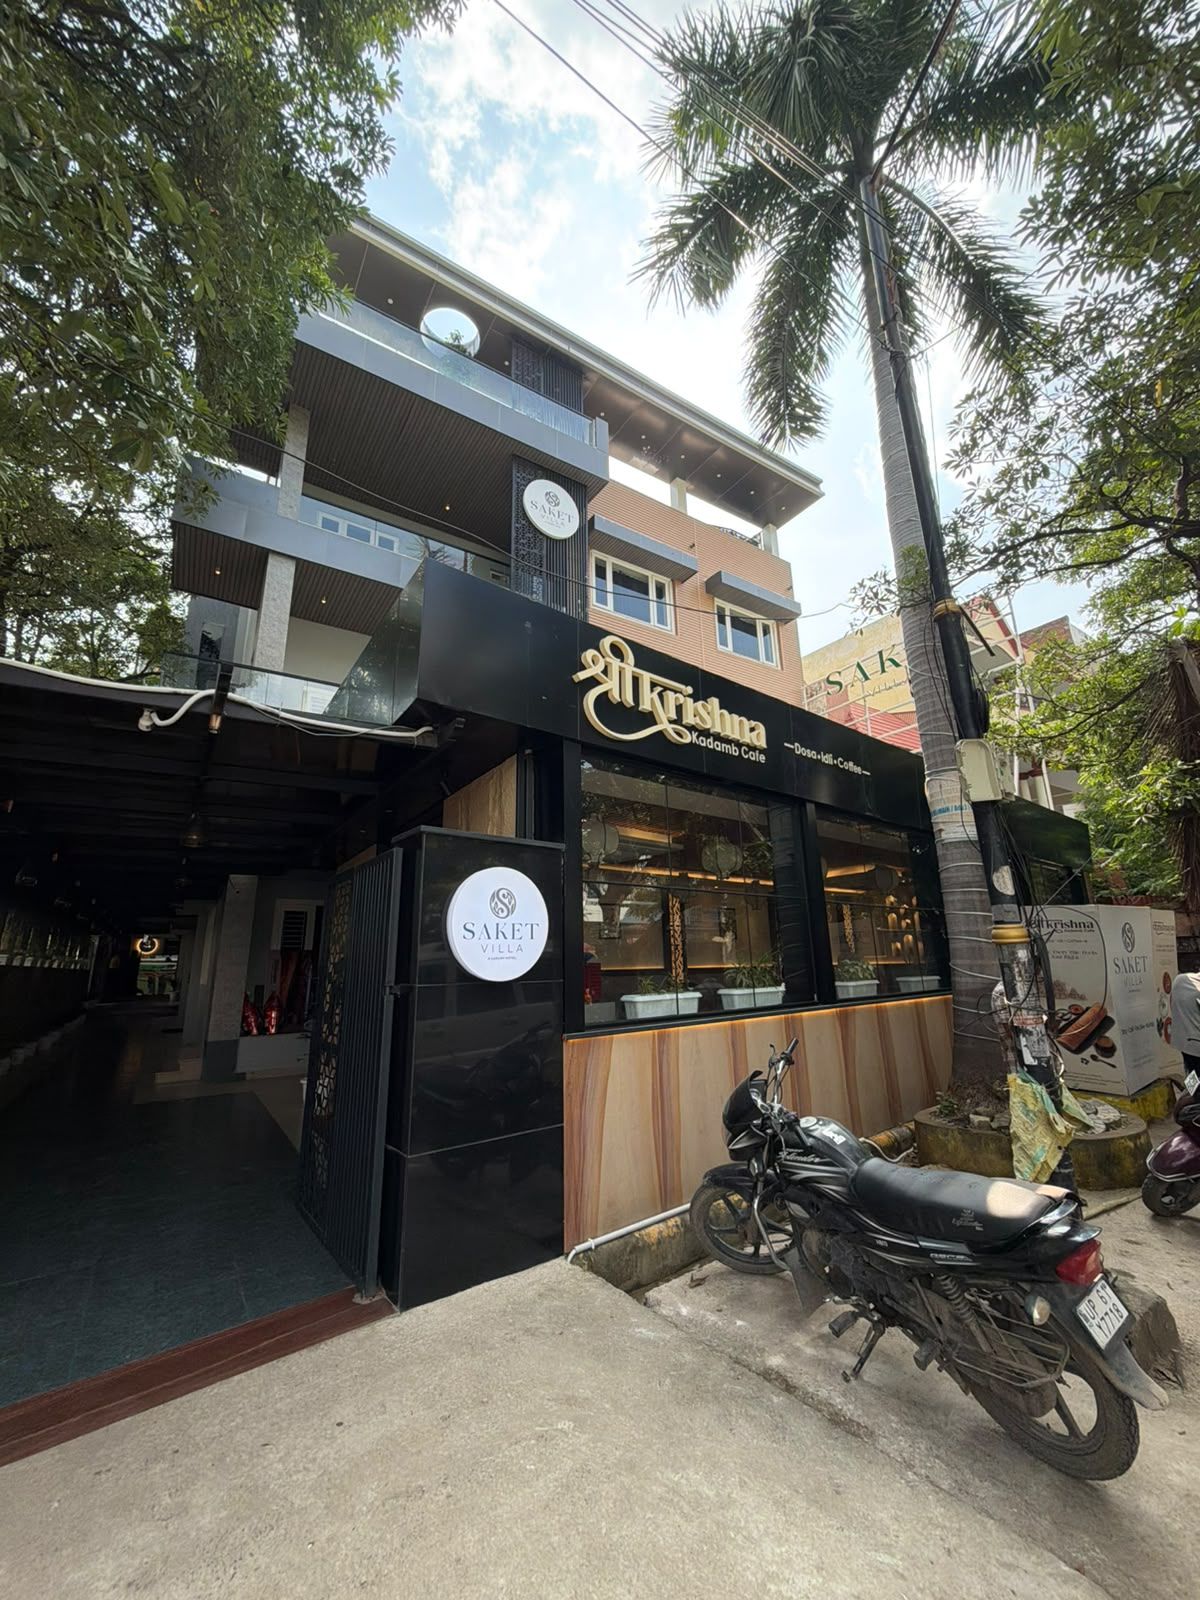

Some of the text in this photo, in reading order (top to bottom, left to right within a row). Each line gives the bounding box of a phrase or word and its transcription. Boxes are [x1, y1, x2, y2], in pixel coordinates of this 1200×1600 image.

[530, 499, 574, 524] SAKET
[825, 643, 902, 696] SAK
[691, 730, 767, 765] Kadamb Cafe
[462, 921, 540, 941] SAKET
[480, 943, 524, 954] VILLA
[1113, 955, 1148, 975] SAKET
[1084, 1299, 1099, 1321] UP
